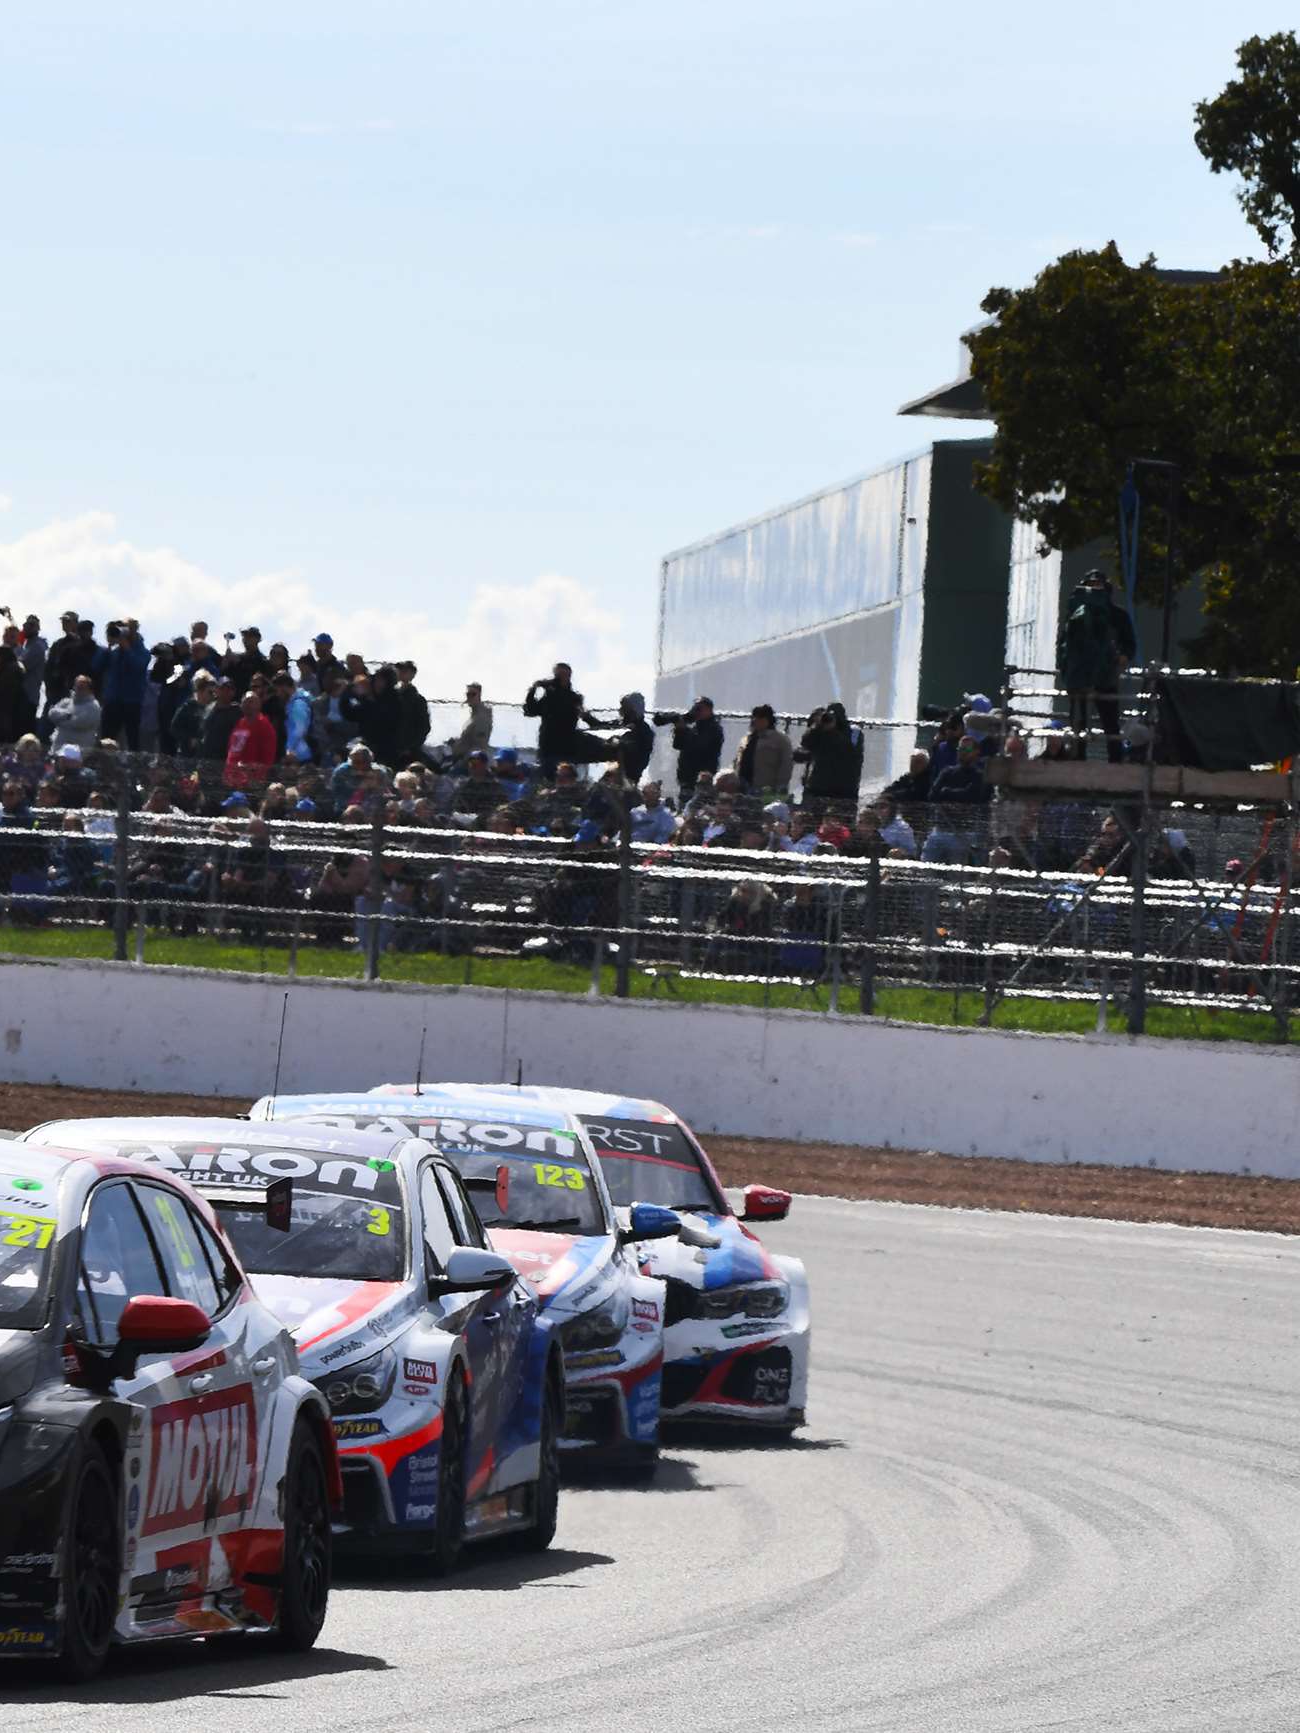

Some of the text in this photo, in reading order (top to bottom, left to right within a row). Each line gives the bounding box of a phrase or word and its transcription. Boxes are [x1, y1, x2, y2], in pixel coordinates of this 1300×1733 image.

[587, 1123, 672, 1154] RST
[234, 1174, 269, 1186] UK
[533, 1162, 587, 1190] 123
[2, 1219, 54, 1250] 21
[367, 1208, 390, 1237] 3
[148, 1403, 254, 1519] MOTUL
